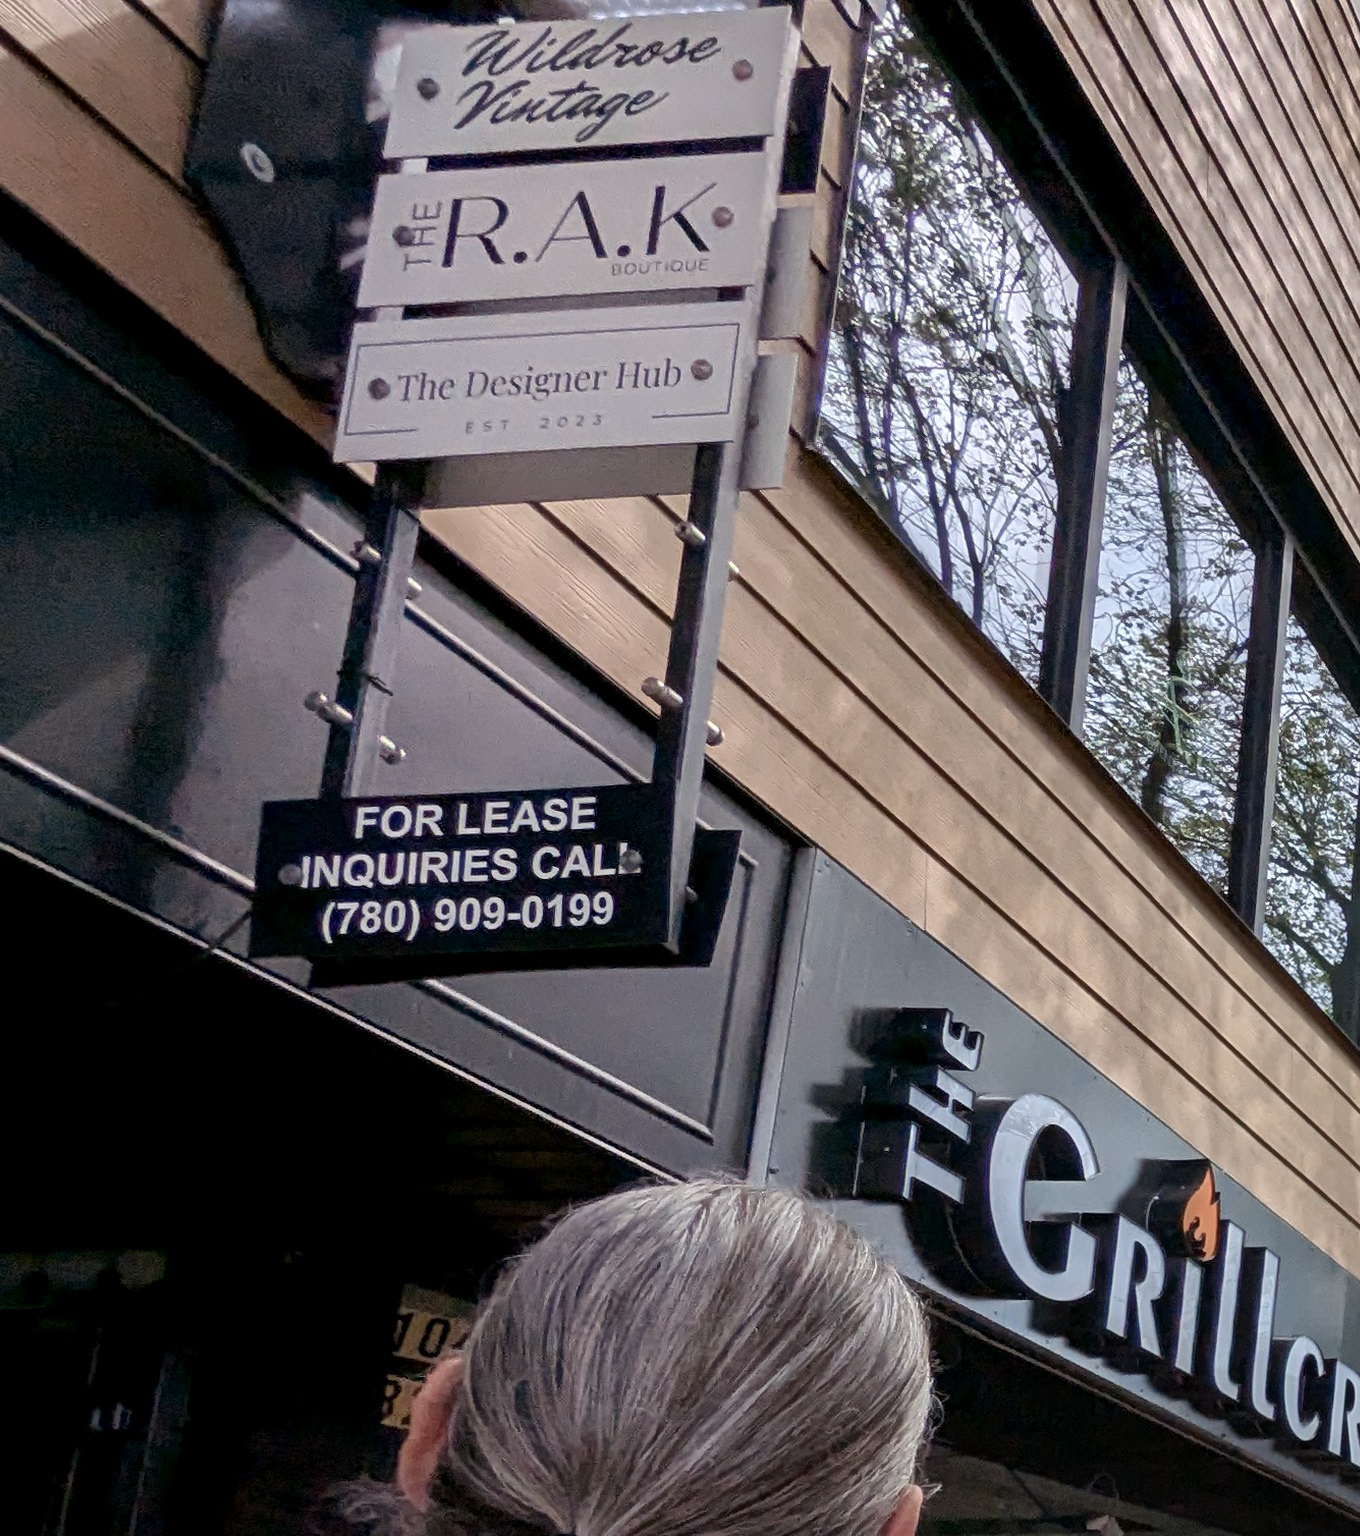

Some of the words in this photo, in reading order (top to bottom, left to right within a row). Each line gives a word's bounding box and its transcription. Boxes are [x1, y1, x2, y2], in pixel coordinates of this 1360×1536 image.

[461, 23, 722, 79] Wildrose
[454, 80, 670, 142] Vintage
[403, 201, 442, 271] THE
[610, 258, 710, 277] BOUTIQUE
[398, 371, 455, 402] The
[466, 365, 606, 401] Designer
[616, 358, 683, 389] Hub
[465, 419, 511, 434] EST
[539, 414, 607, 431] 2023
[355, 804, 443, 840] FOR
[457, 796, 597, 836] LEASE
[301, 848, 518, 889] INQUIRIES
[531, 842, 642, 880] CALL
[321, 899, 421, 944] (780)
[434, 891, 615, 932] 909-0199
[903, 1009, 985, 1205] THE
